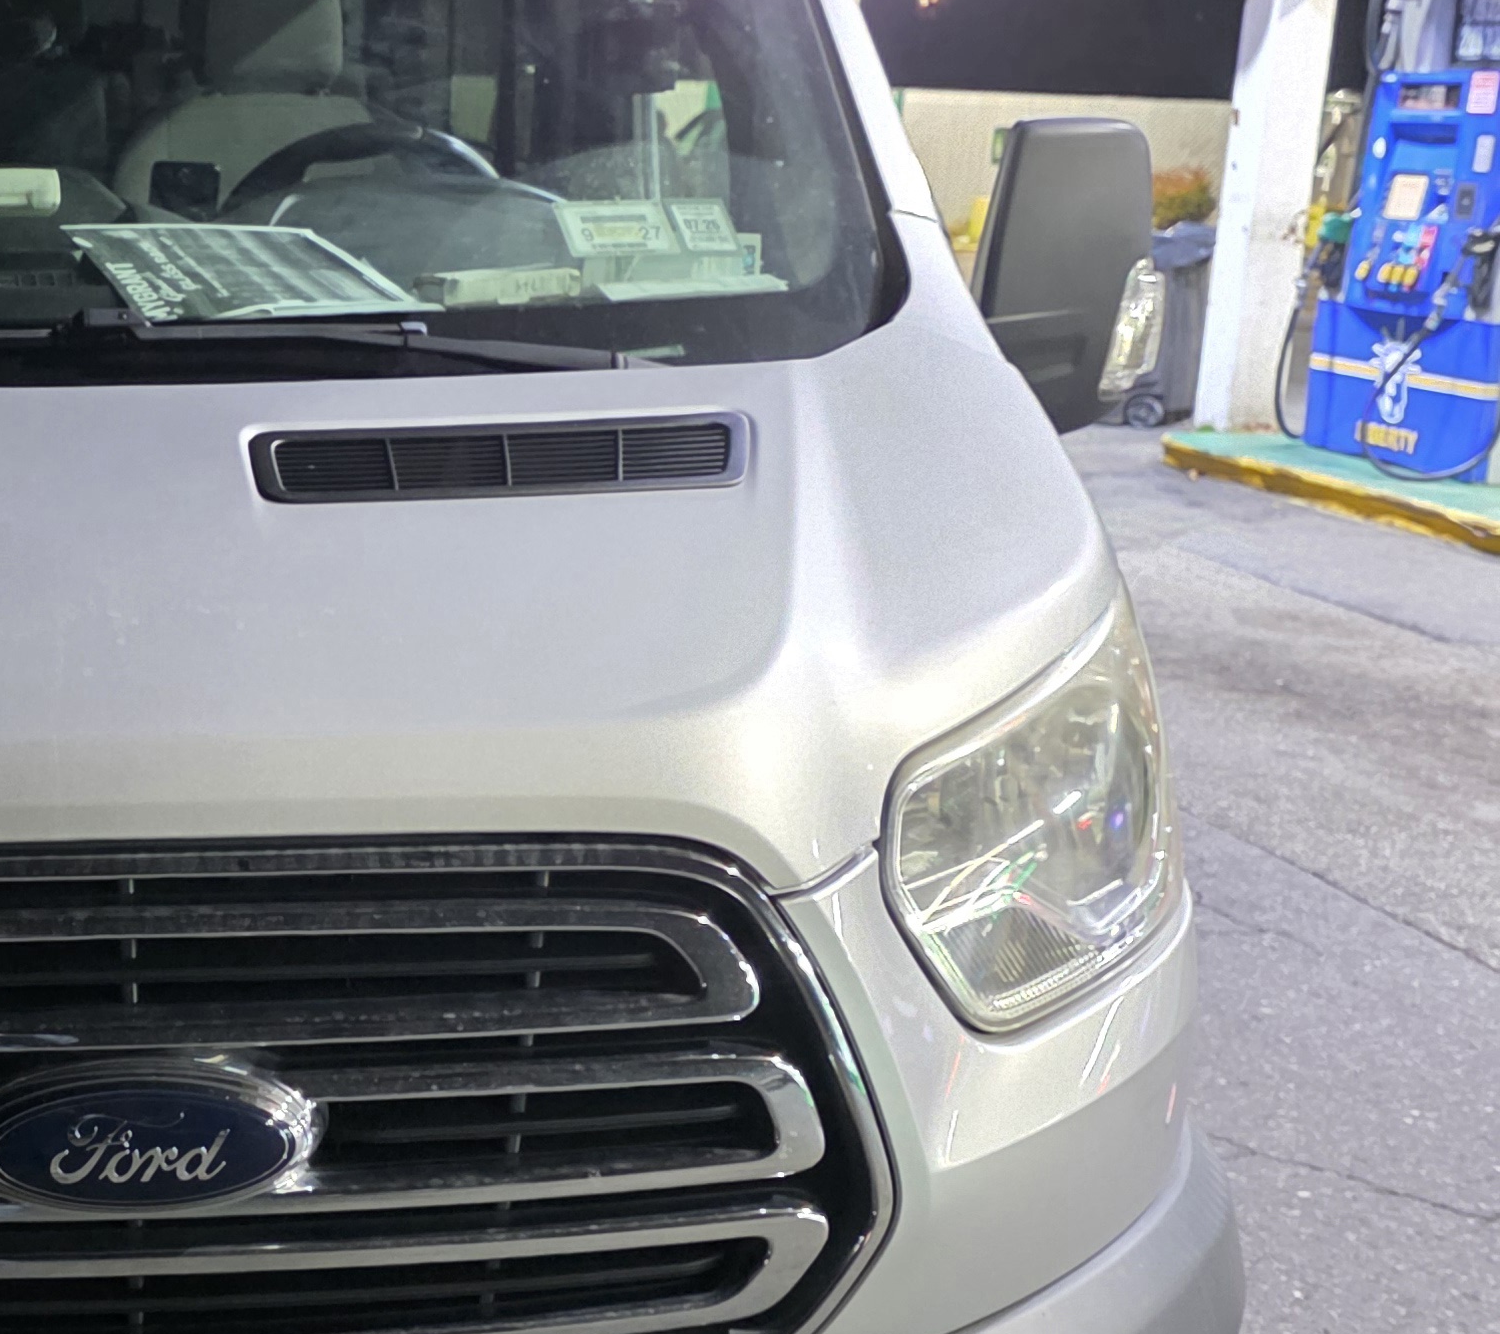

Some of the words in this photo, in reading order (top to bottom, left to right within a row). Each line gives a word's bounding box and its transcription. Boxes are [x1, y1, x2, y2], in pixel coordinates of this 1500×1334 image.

[638, 225, 661, 241] 27
[105, 262, 178, 322] MYGRANT
[50, 1113, 231, 1184] Ford
